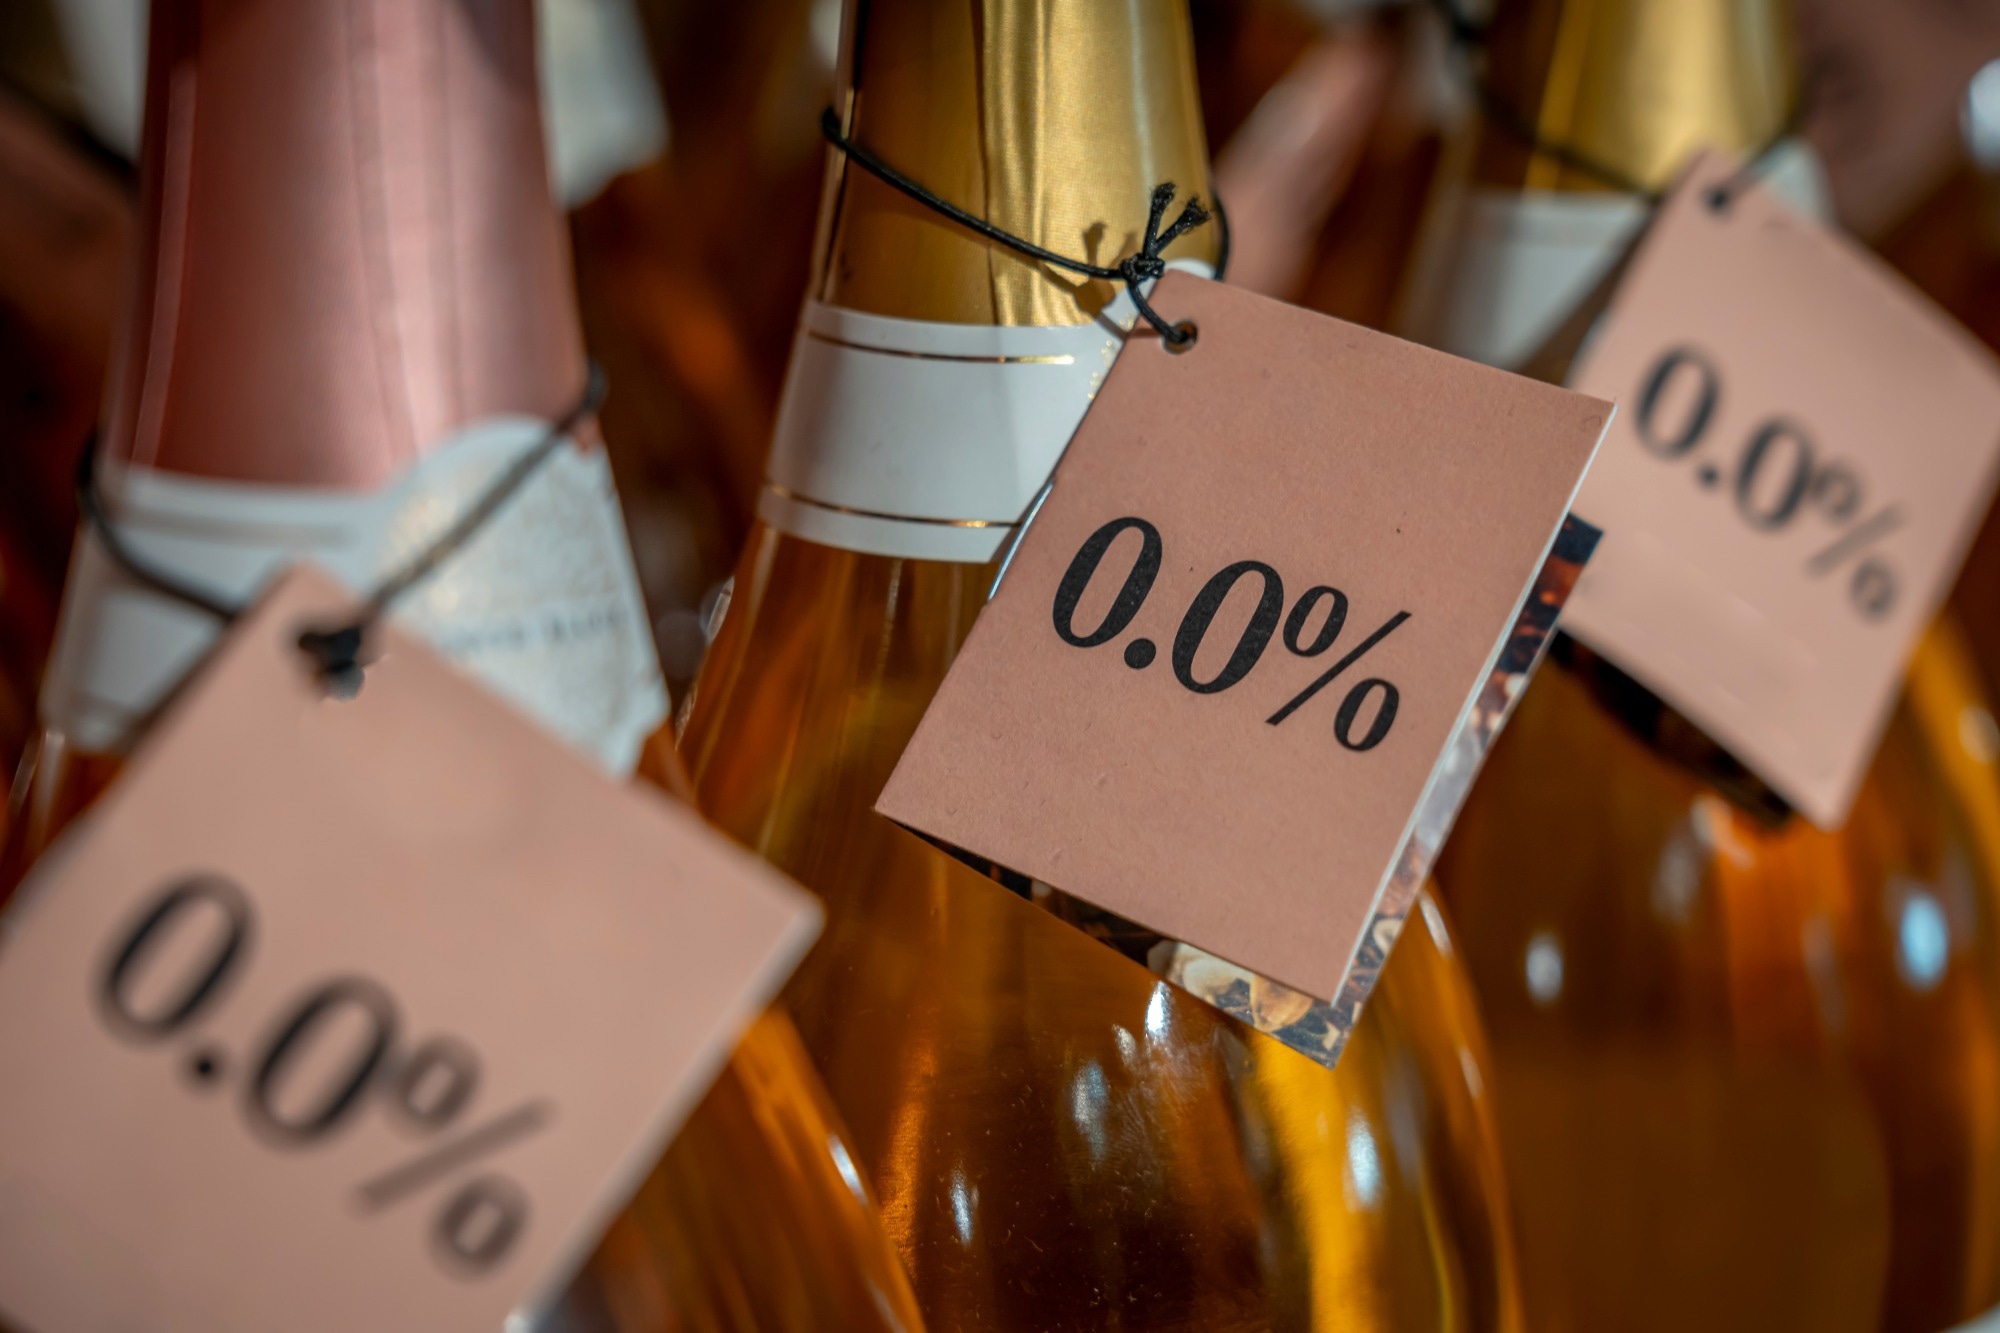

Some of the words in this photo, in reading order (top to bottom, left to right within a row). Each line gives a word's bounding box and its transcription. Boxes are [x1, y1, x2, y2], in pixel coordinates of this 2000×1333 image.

[1632, 343, 1904, 622] 0.0%
[1052, 516, 1412, 753] 0.0%
[93, 872, 555, 1279] 0.0%
